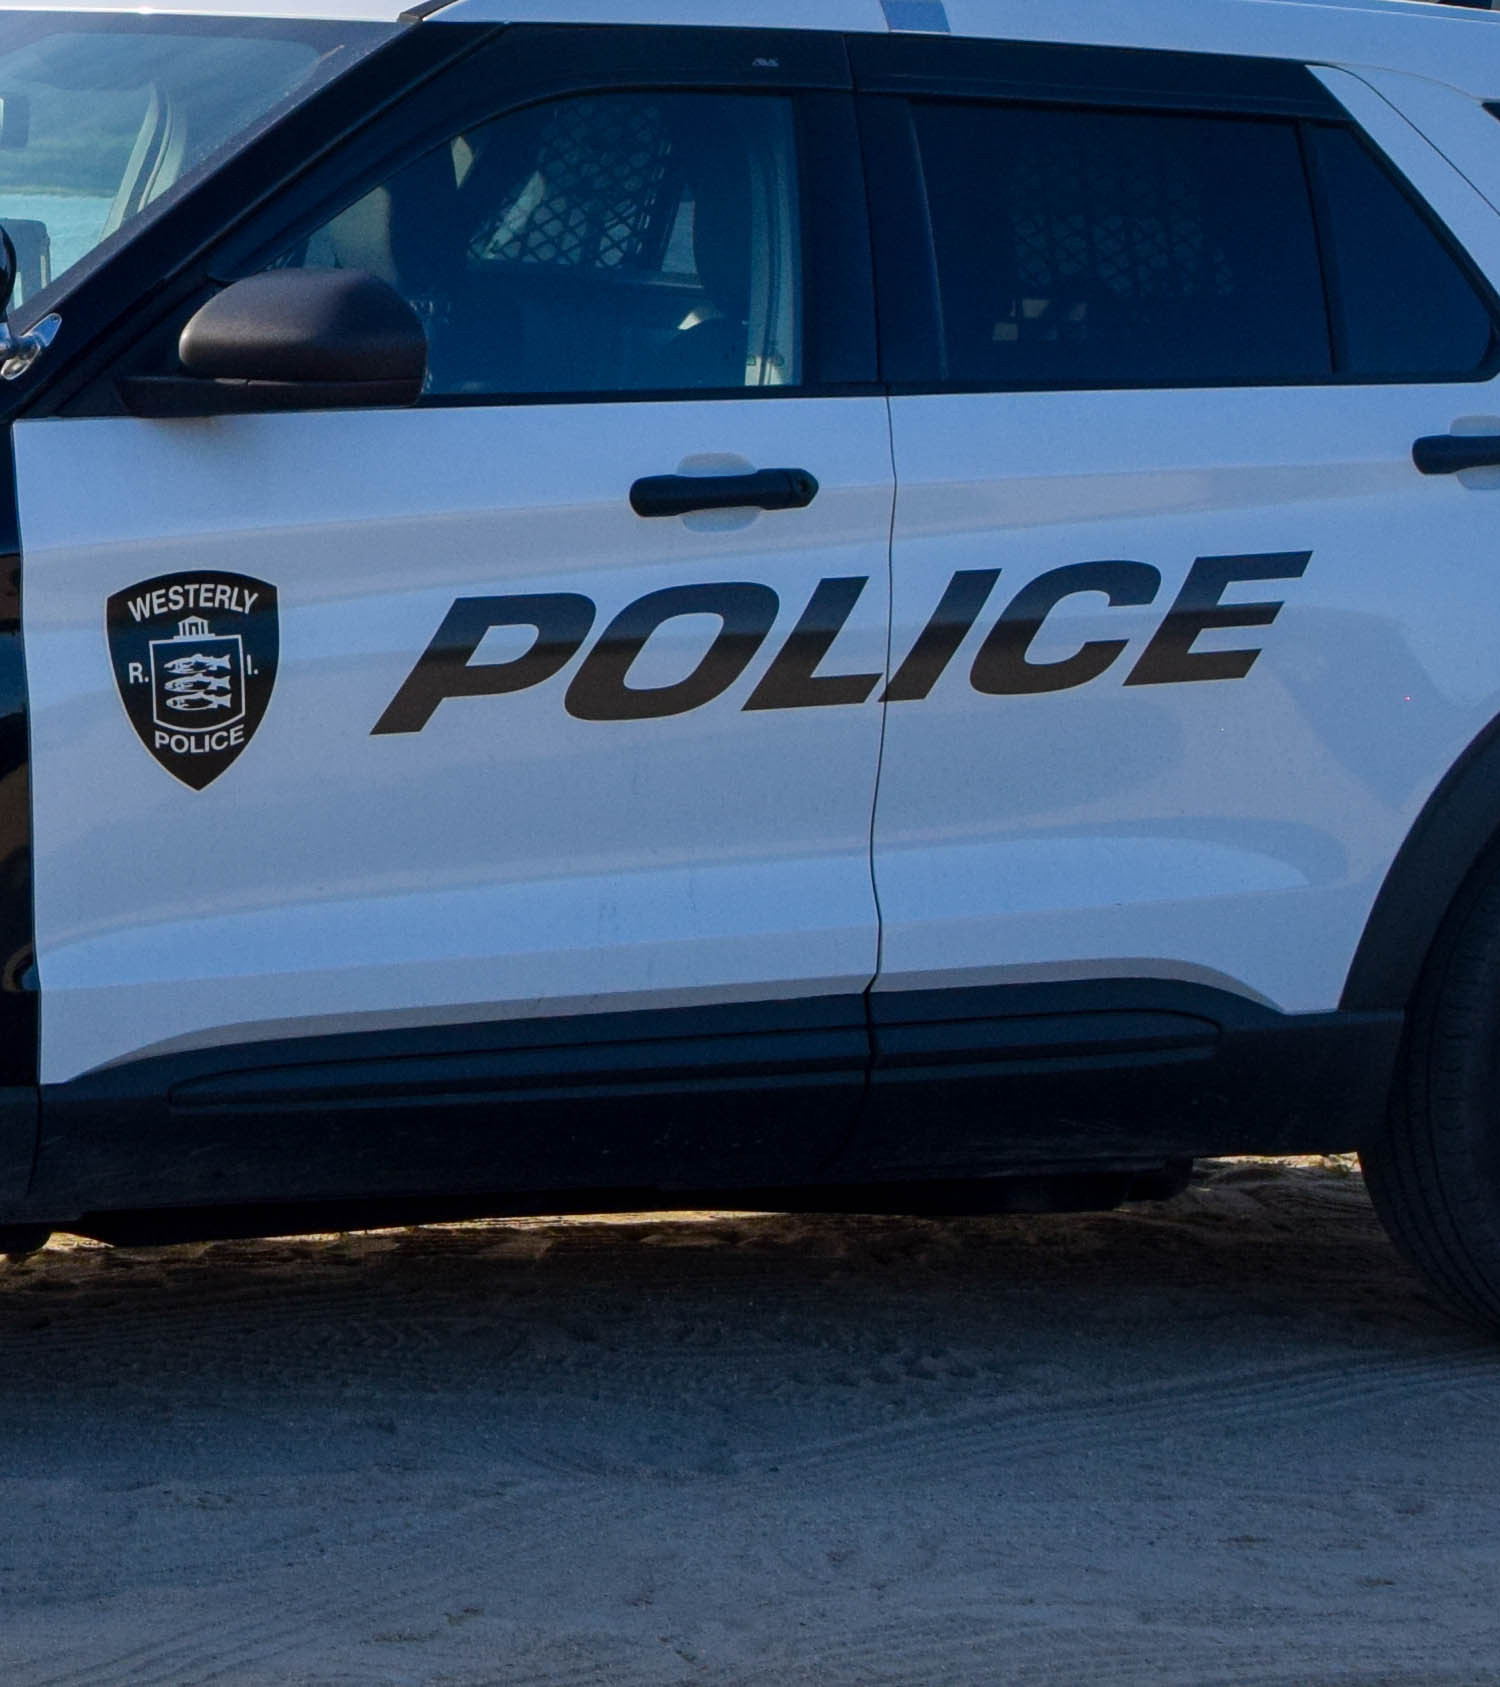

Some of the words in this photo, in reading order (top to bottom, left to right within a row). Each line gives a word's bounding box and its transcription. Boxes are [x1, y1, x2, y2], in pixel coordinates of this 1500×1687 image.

[128, 584, 258, 622] WESTERLY
[369, 550, 1313, 735] POLICE
[154, 724, 245, 754] POLICE
